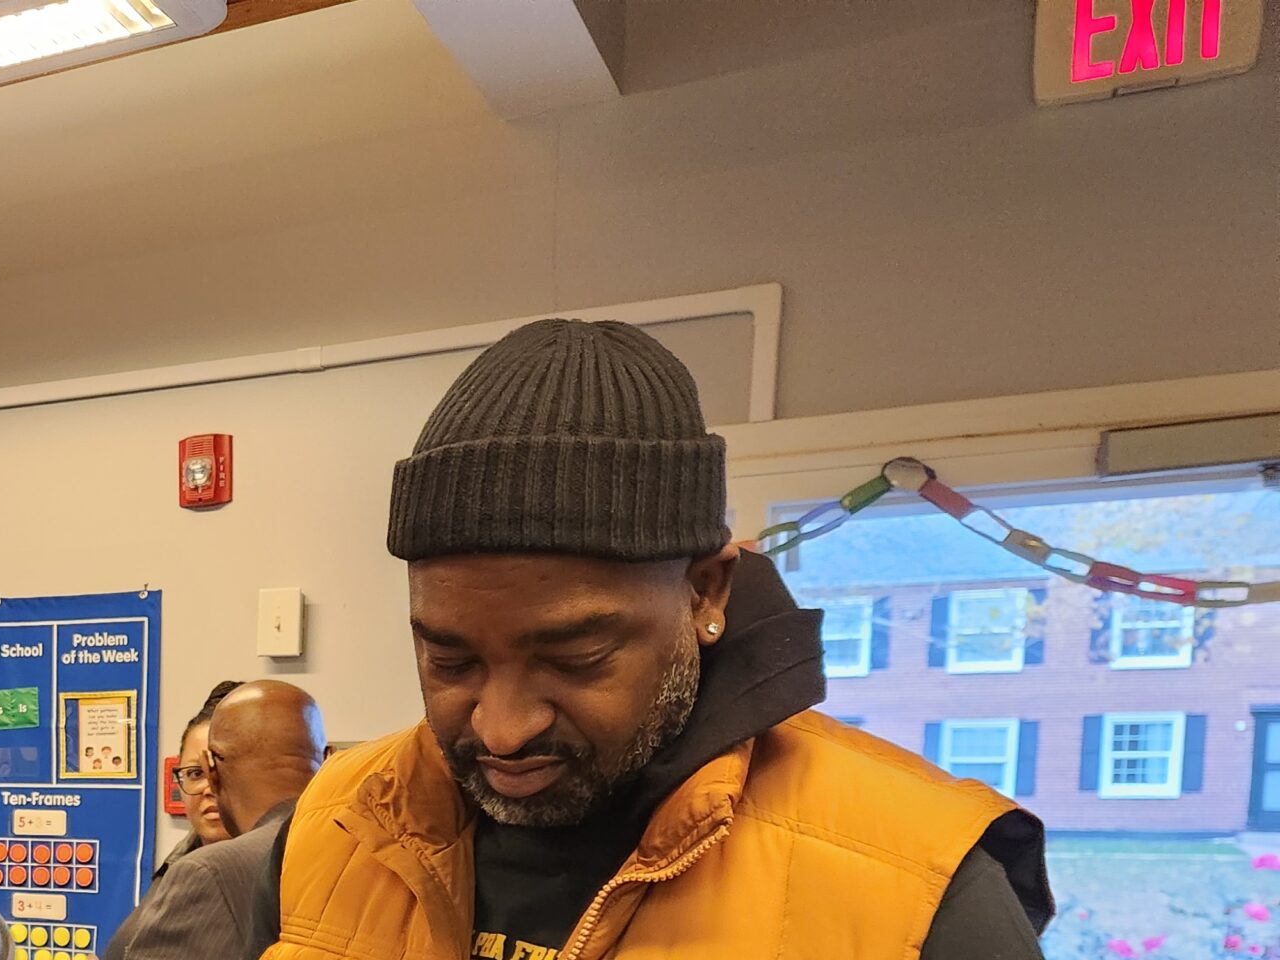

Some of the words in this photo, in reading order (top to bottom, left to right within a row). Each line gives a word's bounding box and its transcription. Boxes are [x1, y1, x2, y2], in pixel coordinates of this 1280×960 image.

[1070, 0, 1221, 83] EXIT
[72, 632, 128, 647] Problem
[1, 643, 43, 658] School
[61, 651, 77, 665] of
[77, 650, 100, 664] the
[101, 648, 139, 663] Week
[19, 703, 28, 713] 1s
[1, 791, 81, 807] Ten-Frames
[472, 931, 507, 960] PHA
